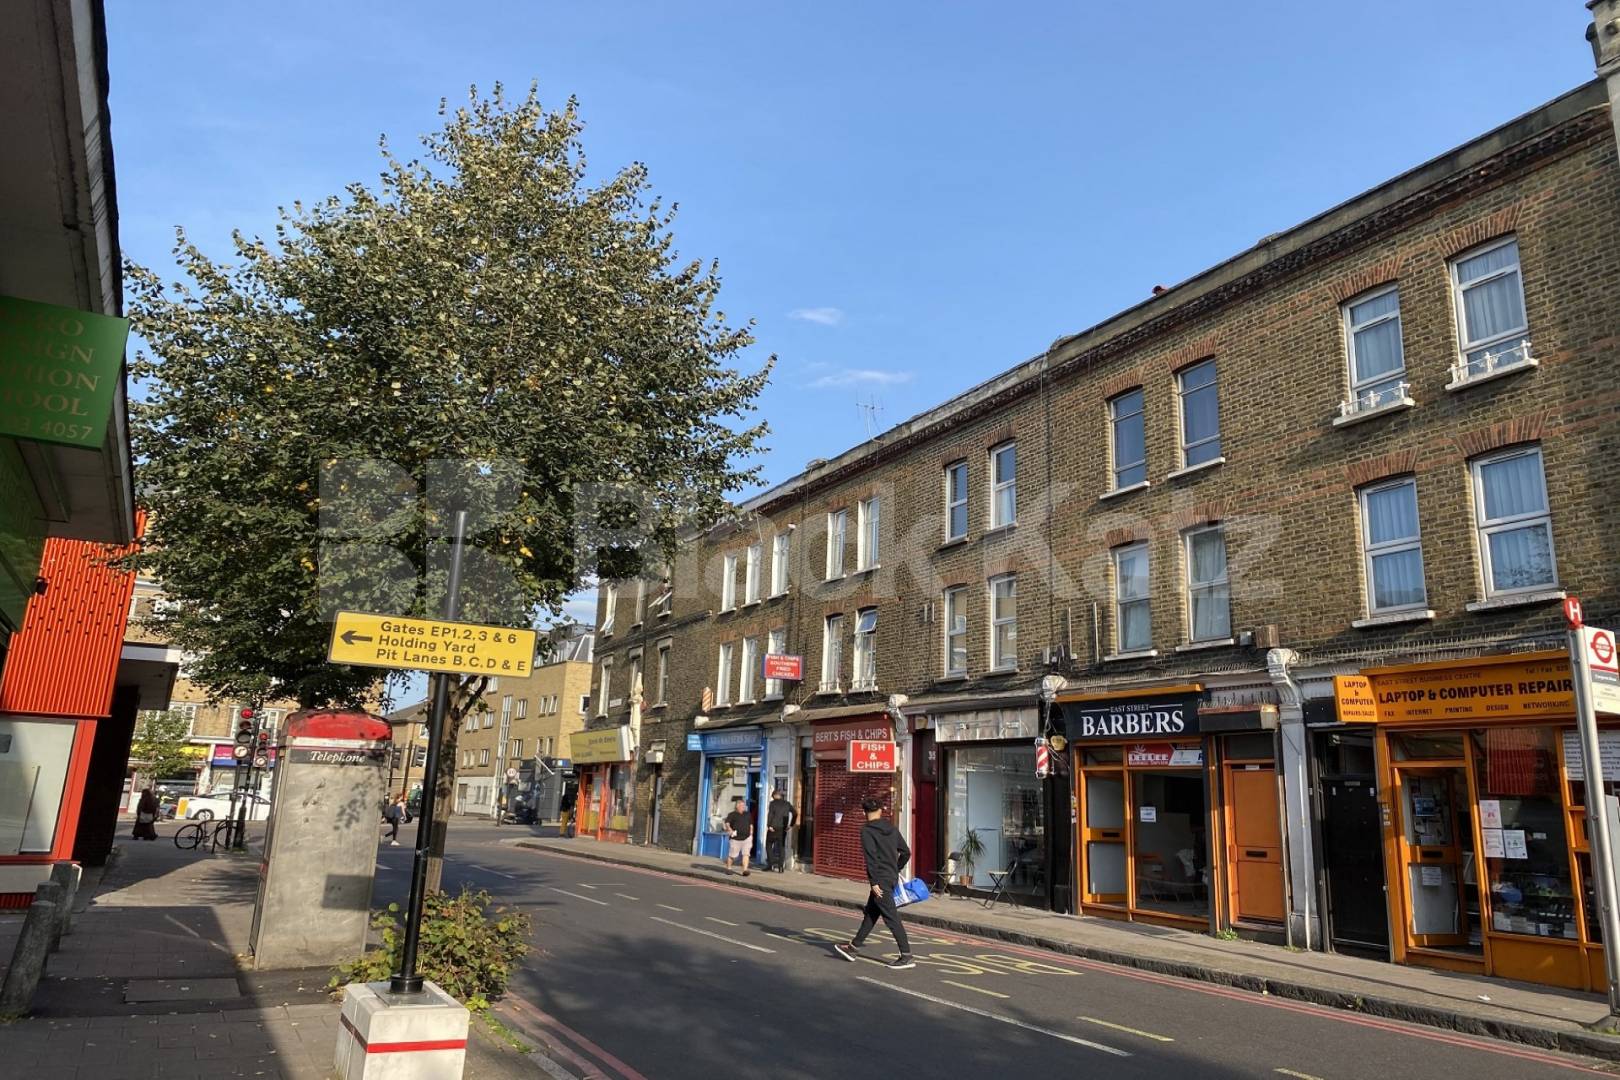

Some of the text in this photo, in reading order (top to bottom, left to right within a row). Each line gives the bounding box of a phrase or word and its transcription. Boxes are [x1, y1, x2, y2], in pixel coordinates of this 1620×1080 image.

[40, 421, 93, 440] 4057
[1569, 603, 1581, 622] H
[380, 621, 425, 636] Gates
[492, 633, 502, 643] &
[507, 634, 517, 644] 6
[379, 635, 476, 654] Holding Yard
[376, 649, 398, 661] Pit
[403, 651, 447, 665] Lanes
[502, 660, 511, 671] &
[517, 661, 526, 671] E
[1379, 679, 1573, 704] LAPTOP & COMPUTER REPAIR
[1110, 704, 1149, 713] EAST STREET
[1406, 708, 1433, 716] INTERNET
[1081, 711, 1185, 737] BARBERS
[815, 727, 887, 743] BERT'S FISH & CHIPS
[310, 751, 366, 763] Telephone
[860, 743, 886, 752] FISH
[856, 760, 890, 770] CHIPS
